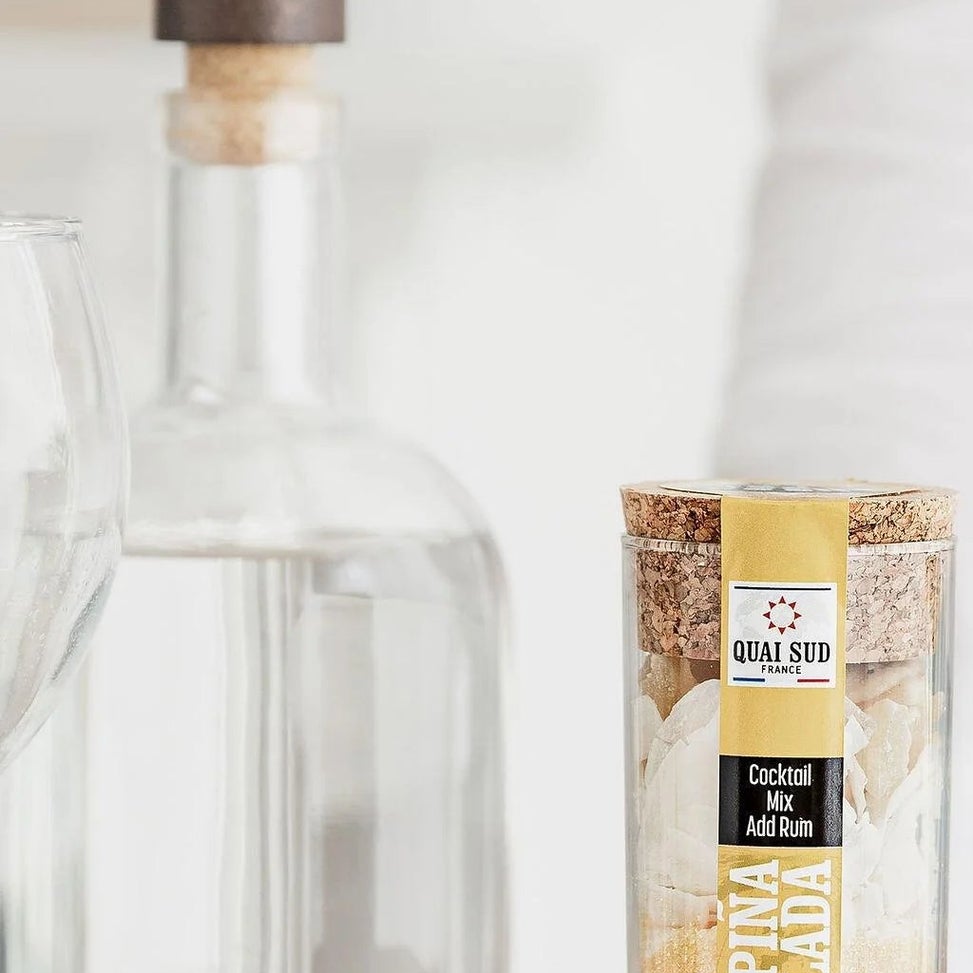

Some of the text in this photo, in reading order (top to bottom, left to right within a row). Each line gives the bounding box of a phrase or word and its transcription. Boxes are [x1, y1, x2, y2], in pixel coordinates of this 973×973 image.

[733, 640, 831, 663] QUAI SUD
[761, 664, 802, 675] FRANCE
[749, 763, 812, 786] Cocktail
[767, 790, 794, 812] Mix
[746, 815, 813, 838] Add Rum
